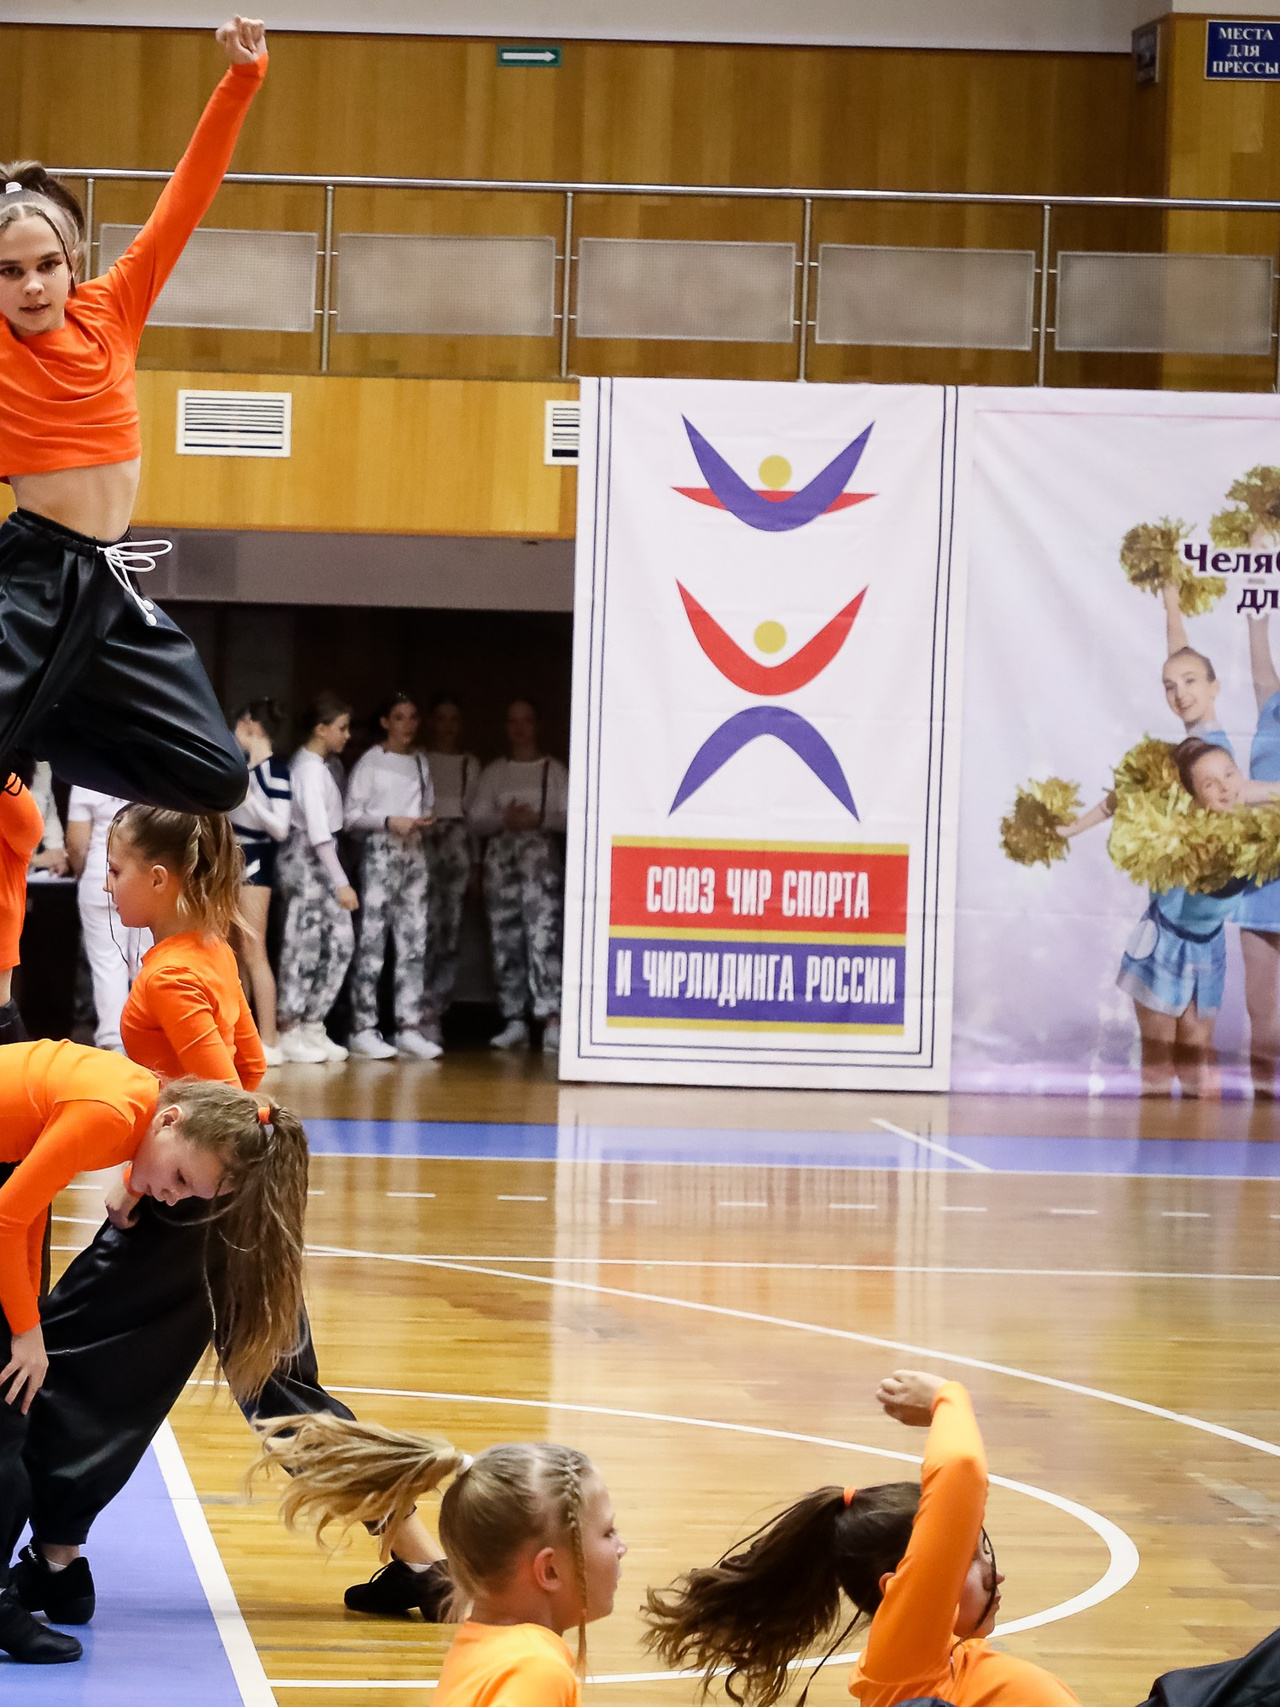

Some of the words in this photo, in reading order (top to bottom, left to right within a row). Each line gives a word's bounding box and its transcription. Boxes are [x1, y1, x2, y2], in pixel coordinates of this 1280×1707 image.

[1220, 27, 1274, 41] МЕСТА
[1227, 44, 1260, 58] ДЛЯ
[1212, 61, 1279, 75] ПРЕССЫ
[1184, 543, 1280, 574] Челя
[646, 865, 716, 914] СОЮЗ
[726, 868, 772, 916] ЧИР
[782, 869, 869, 919] СПОРТА
[615, 949, 632, 997] И
[642, 950, 795, 1008] ЧИРЛИДИНГА
[805, 955, 896, 1005] РОССИИ
